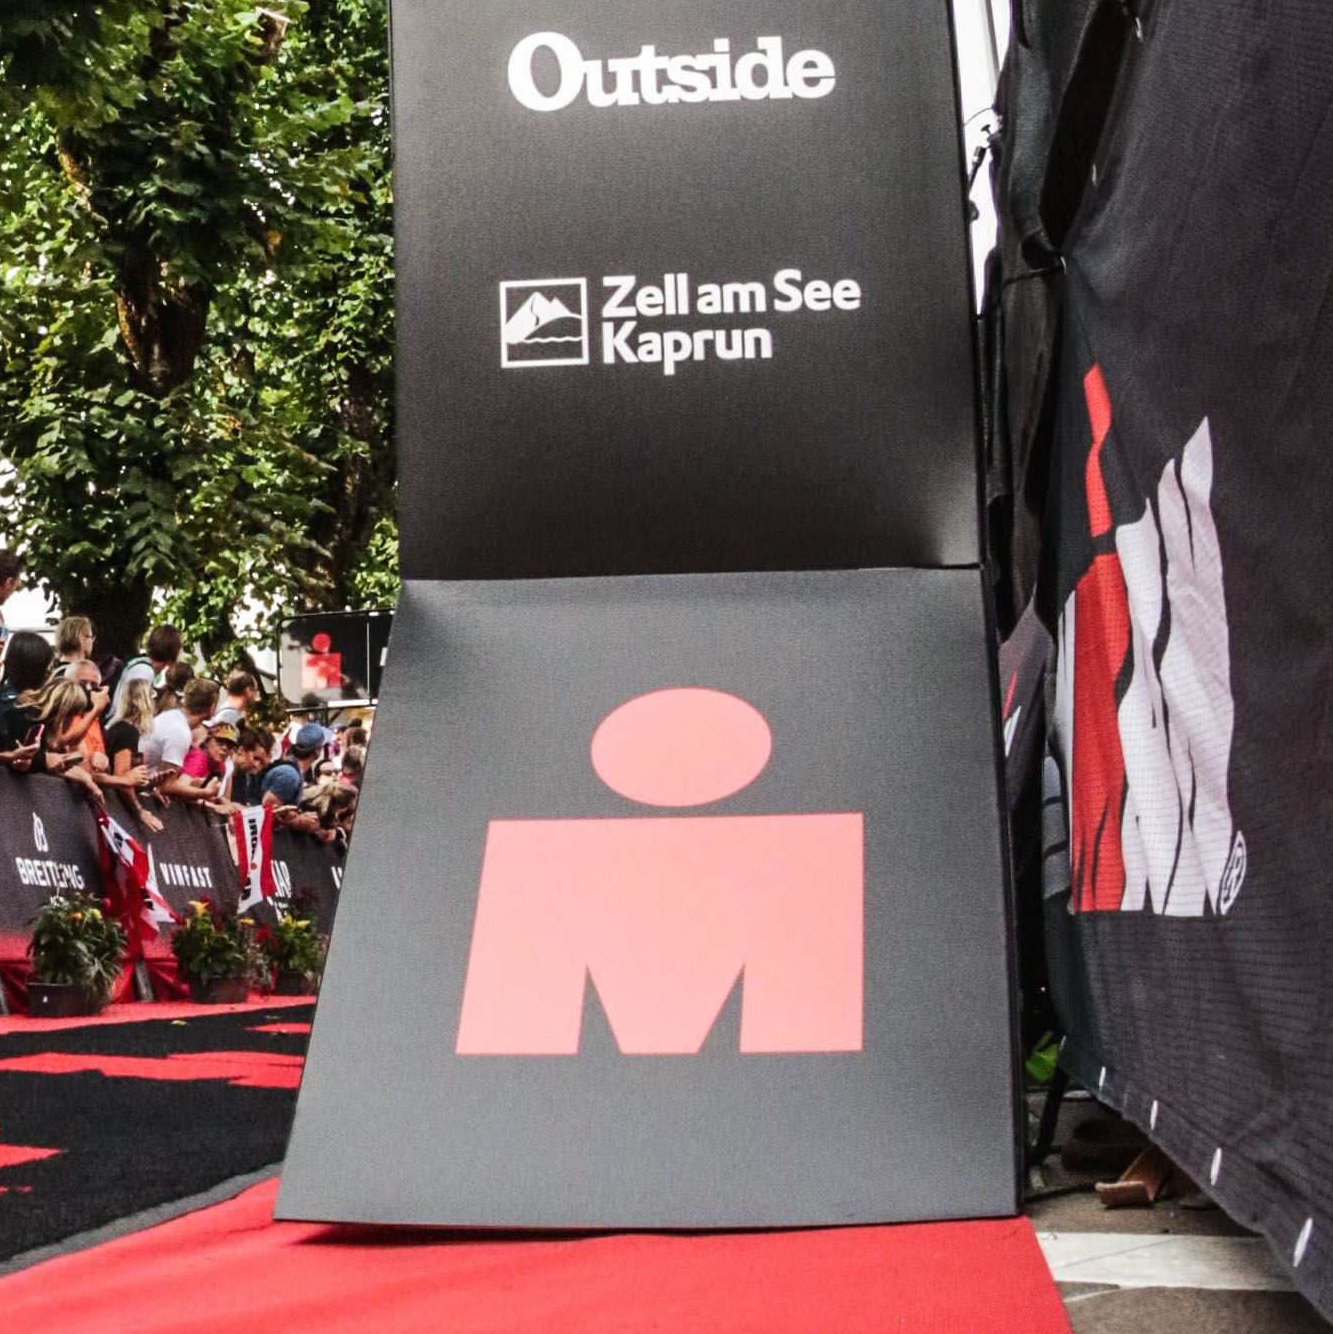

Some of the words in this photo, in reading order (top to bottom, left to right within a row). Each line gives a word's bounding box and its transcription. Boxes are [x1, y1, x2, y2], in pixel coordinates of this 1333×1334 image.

[507, 31, 836, 111] Outside
[602, 273, 687, 317] Zell
[696, 279, 766, 314] am
[773, 269, 861, 312] See
[601, 321, 773, 376] Kaprun
[159, 862, 213, 888] VINFAST
